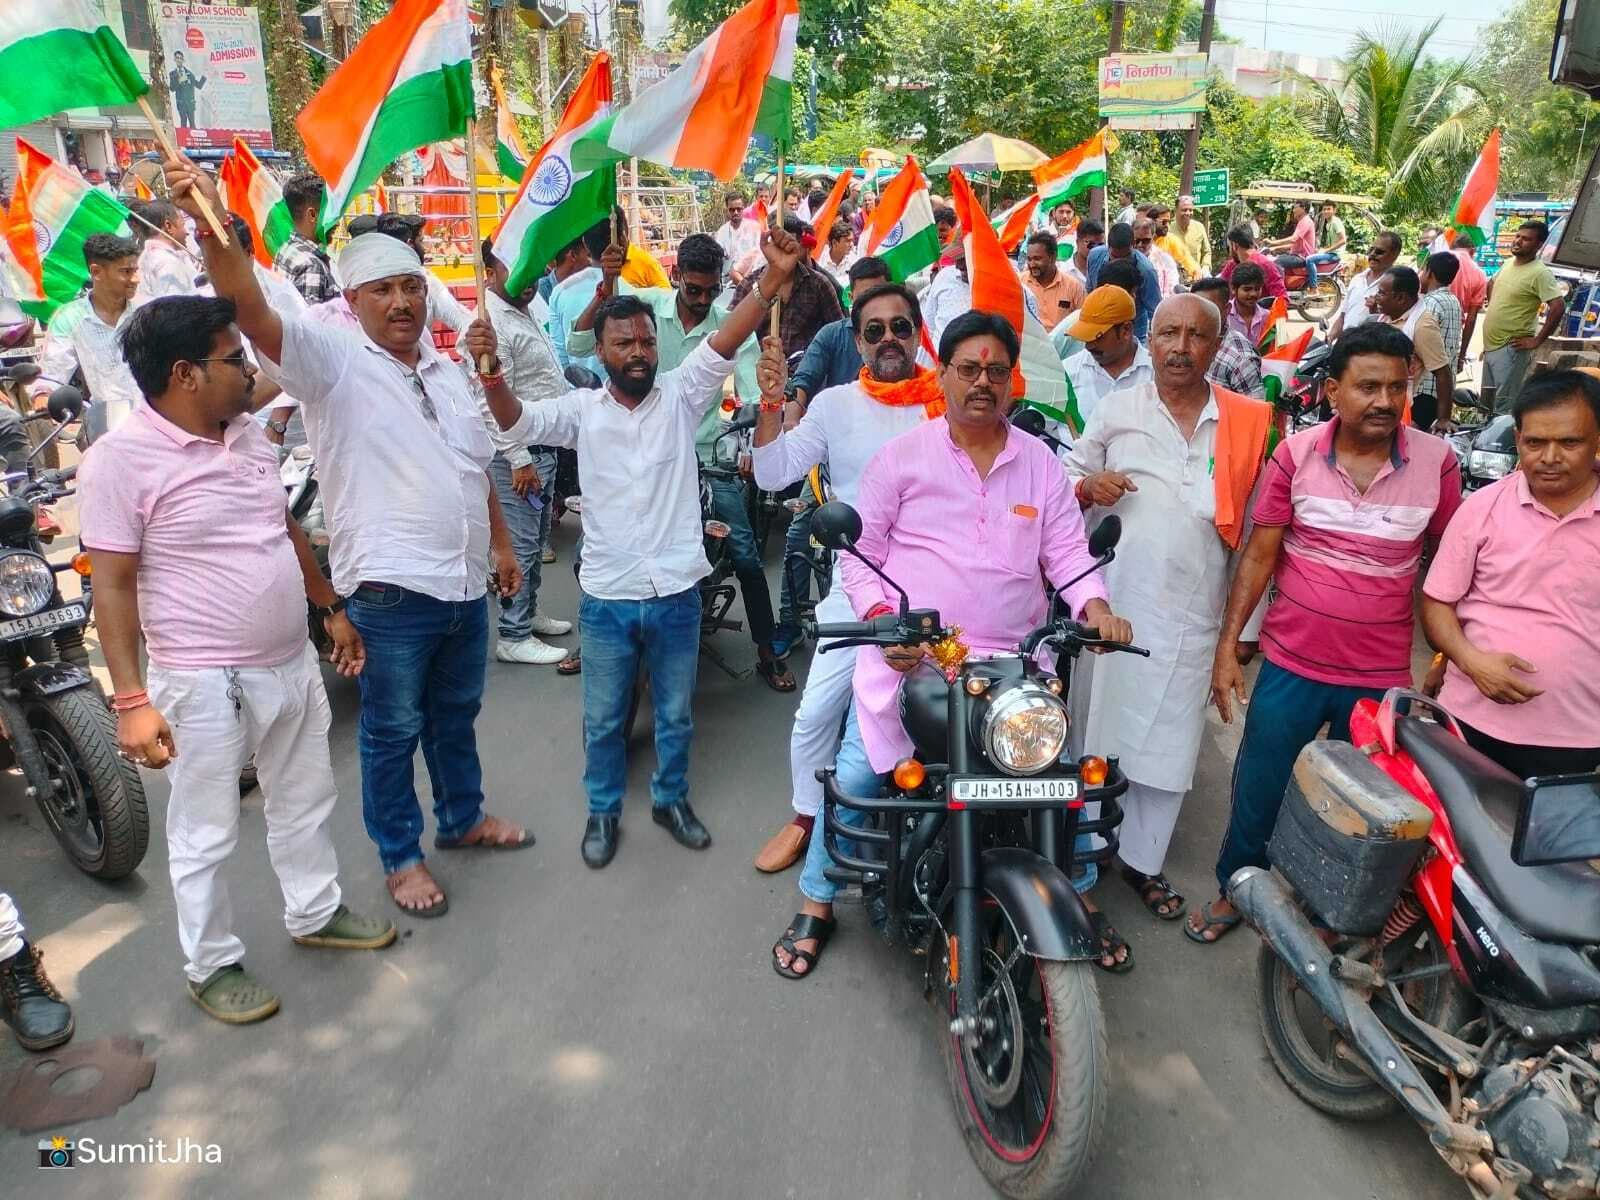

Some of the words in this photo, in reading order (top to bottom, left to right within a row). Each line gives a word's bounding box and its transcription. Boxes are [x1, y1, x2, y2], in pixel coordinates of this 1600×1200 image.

[176, 5, 213, 15] SHALOM
[213, 7, 247, 16] SCHOOL
[210, 47, 256, 61] ADMISSION
[1126, 64, 1172, 78] निर्माण
[998, 782, 1032, 797] 15AH
[1041, 782, 1074, 797] 1003
[1476, 926, 1499, 957] Hero
